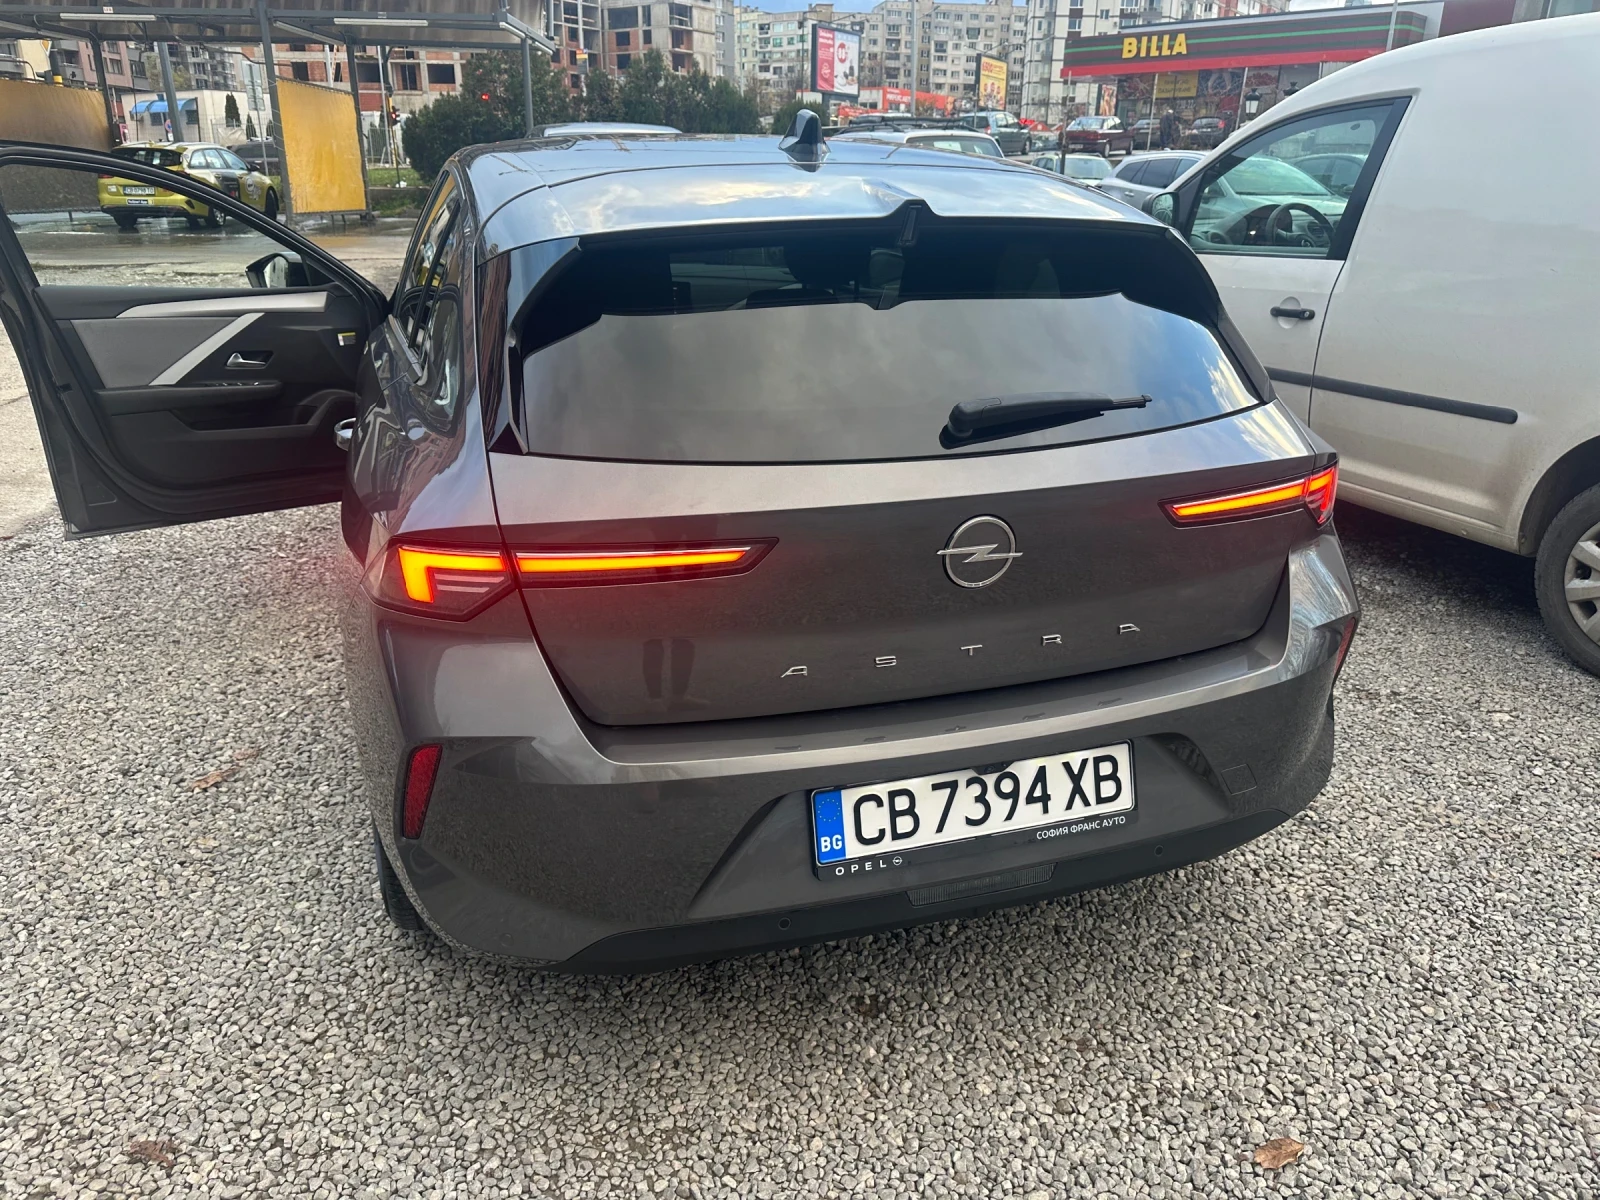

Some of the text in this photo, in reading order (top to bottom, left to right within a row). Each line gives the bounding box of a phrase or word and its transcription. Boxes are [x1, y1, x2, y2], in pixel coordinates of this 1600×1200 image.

[1122, 33, 1187, 58] BILLA
[781, 623, 1140, 678] ASTRA
[853, 754, 1122, 846] CB 7394 XB
[1036, 815, 1126, 840] СОФИЯ ФРАНС АУТО
[821, 835, 843, 852] BG
[835, 859, 887, 876] OPEL
